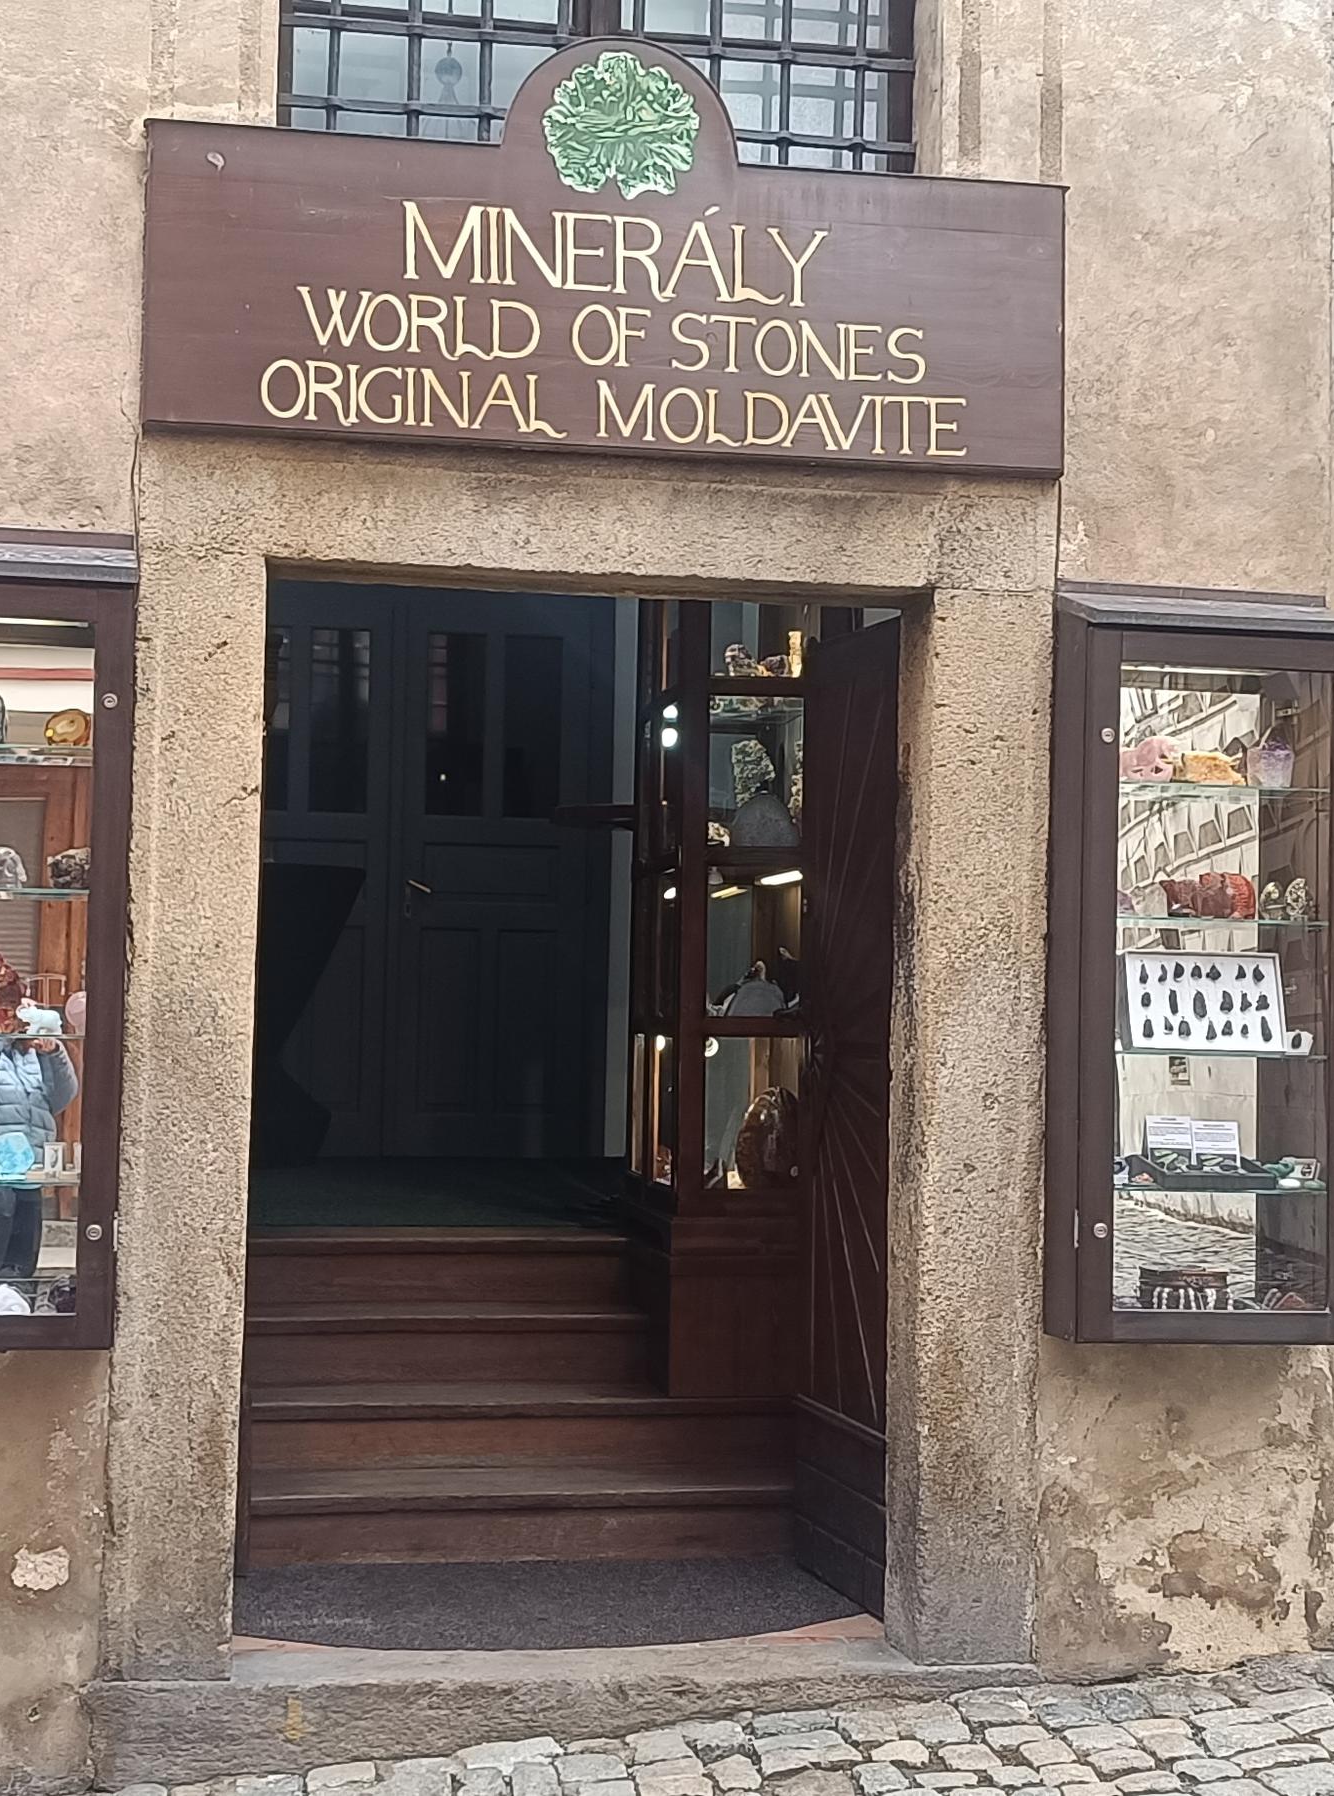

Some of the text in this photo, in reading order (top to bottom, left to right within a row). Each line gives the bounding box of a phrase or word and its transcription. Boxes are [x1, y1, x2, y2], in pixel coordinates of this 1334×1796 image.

[401, 200, 828, 308] MINERÁLY
[297, 286, 927, 384] WORLD OF STONES
[260, 359, 968, 457] ORIGINAL MOLDAVITE
